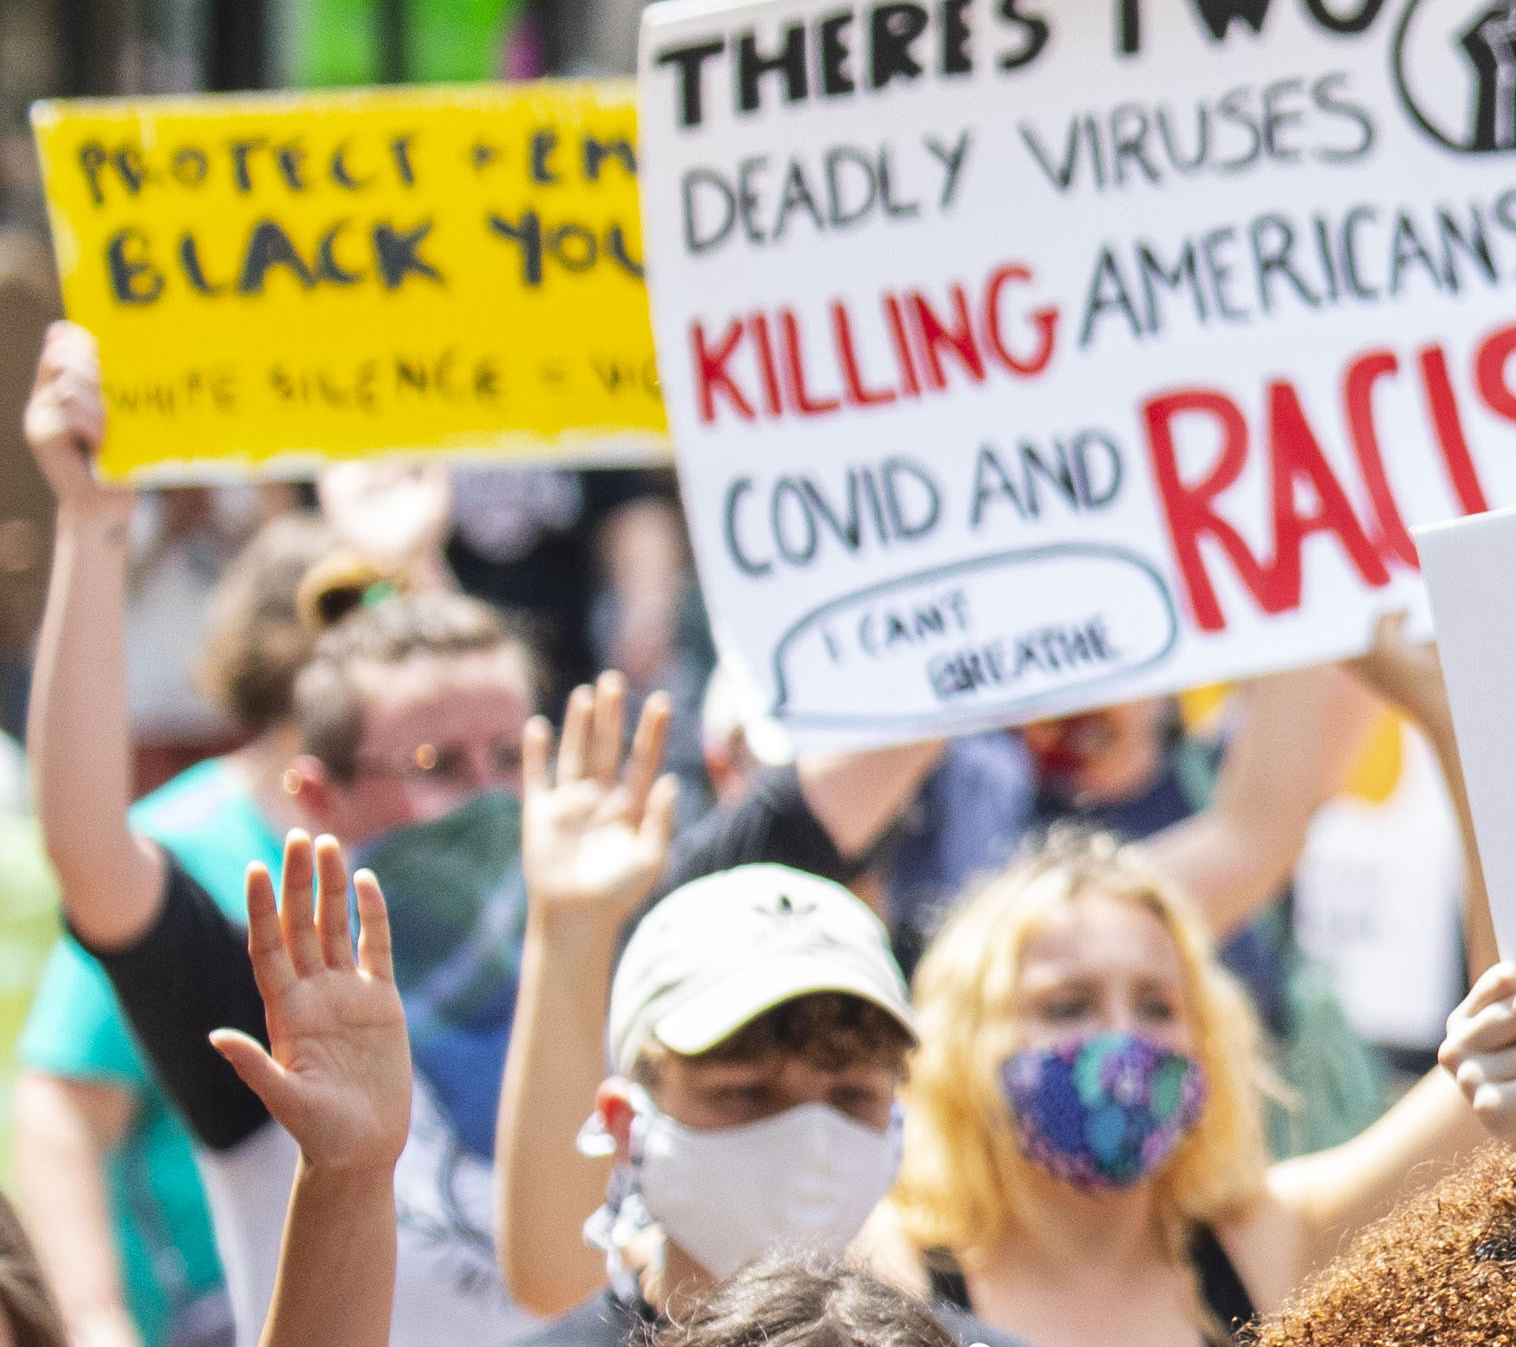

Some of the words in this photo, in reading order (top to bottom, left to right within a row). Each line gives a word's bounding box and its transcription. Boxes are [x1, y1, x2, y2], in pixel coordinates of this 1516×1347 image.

[75, 128, 420, 208] PROTECT
[680, 124, 978, 255] DEADLY
[1018, 70, 1378, 194] VIRUSES
[103, 216, 446, 306] BLACK
[101, 360, 238, 419] WHITE
[266, 347, 500, 415] SILENCE
[690, 262, 1061, 425] KILLING
[723, 455, 942, 577] COVID
[968, 425, 1124, 533] AND
